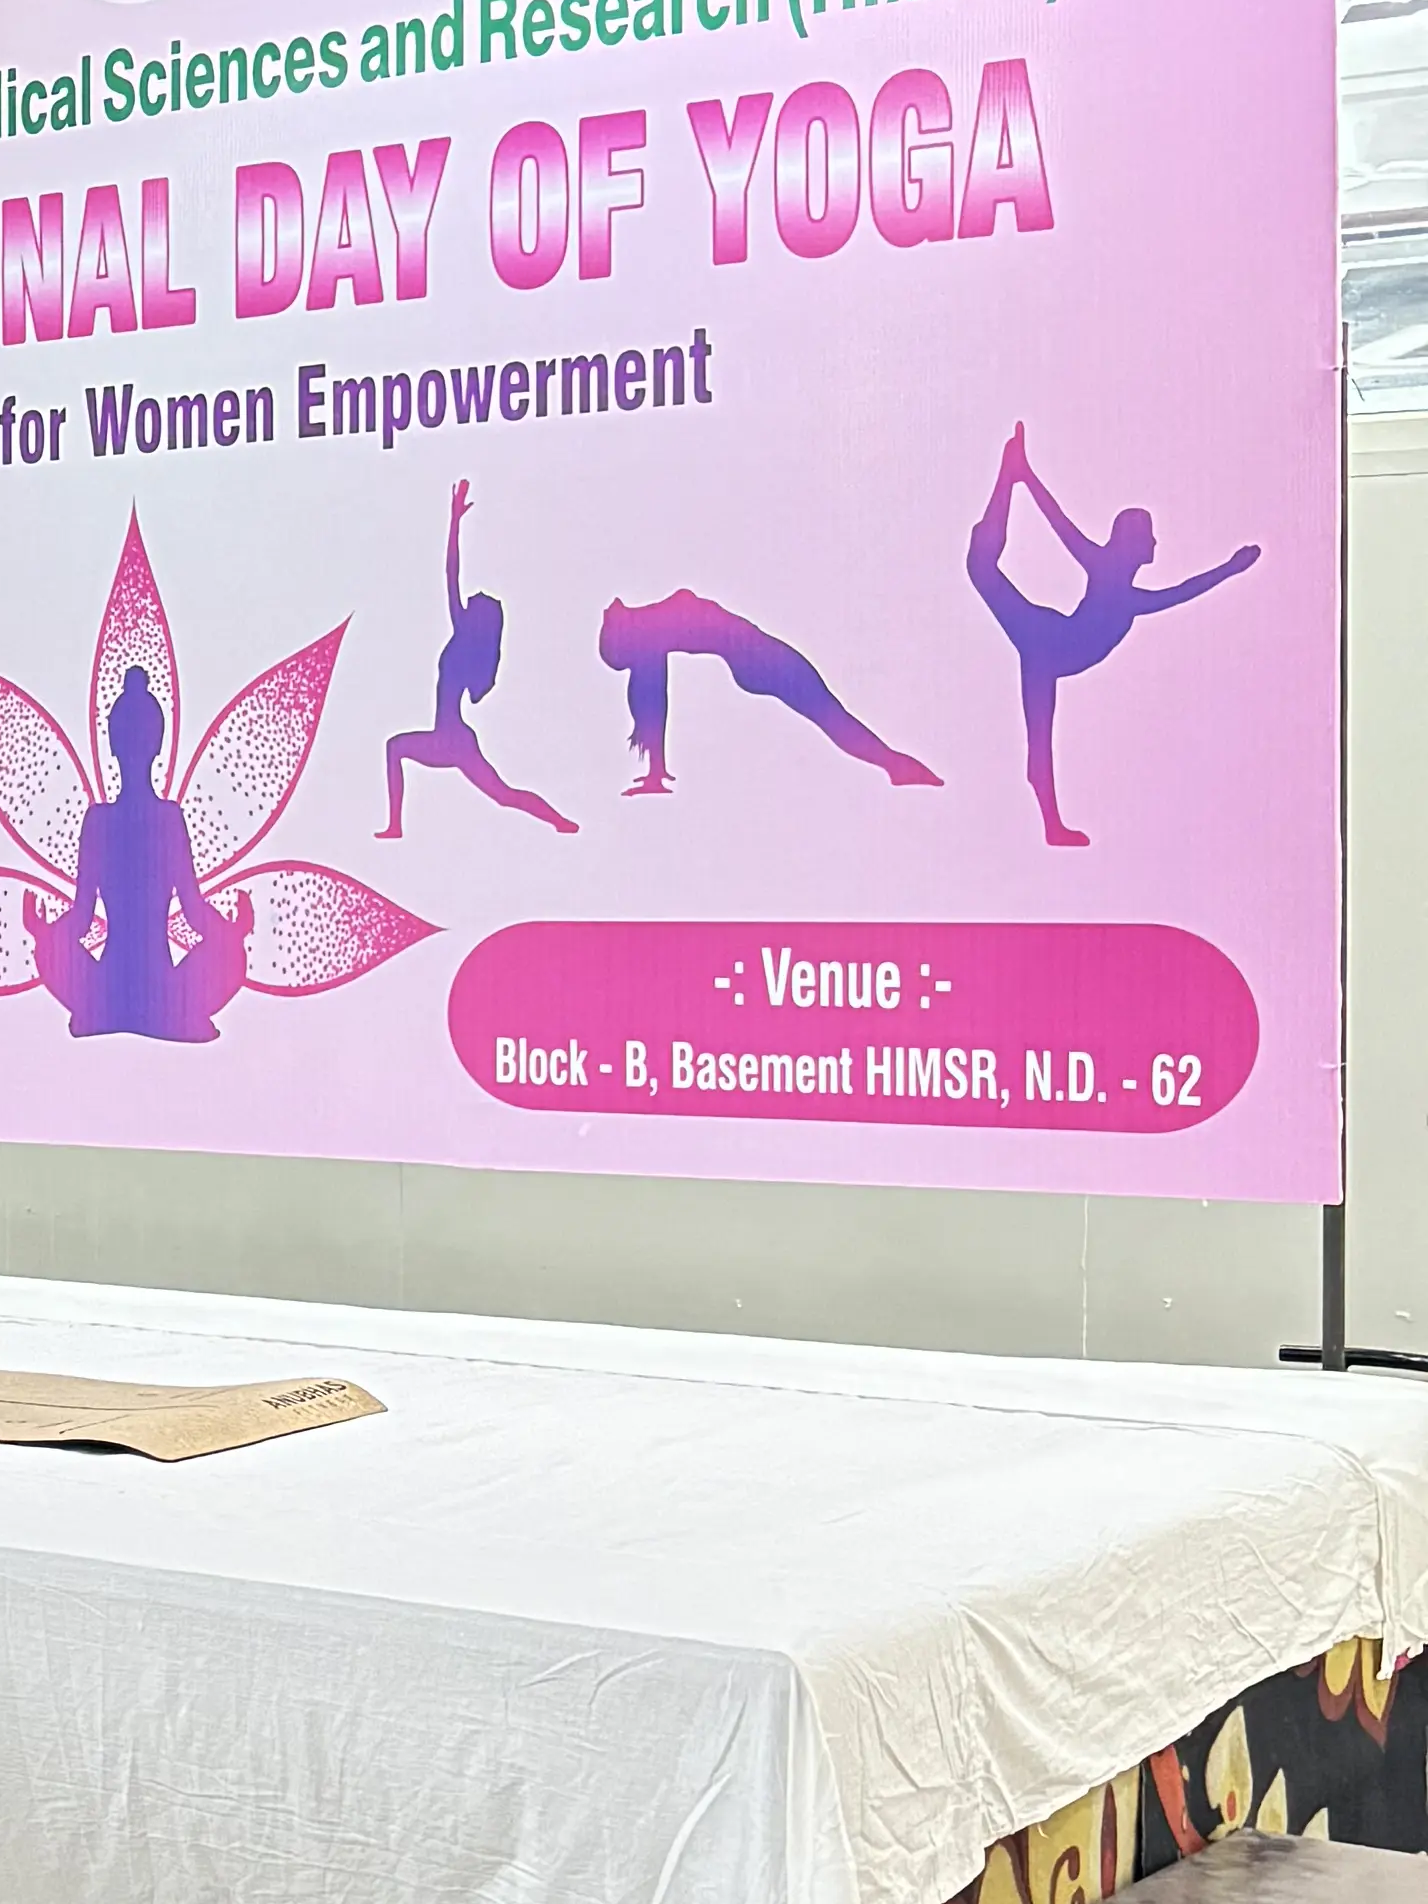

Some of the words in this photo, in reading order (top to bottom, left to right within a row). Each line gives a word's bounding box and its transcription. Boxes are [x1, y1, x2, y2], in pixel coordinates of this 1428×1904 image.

[104, 38, 347, 123] Sciences
[235, 137, 452, 319] DAY
[489, 109, 648, 291] OF
[687, 58, 1055, 266] YOGA
[86, 381, 274, 454] Women
[297, 328, 713, 450] Empowerment
[761, 946, 902, 1010] Venue
[494, 1035, 589, 1087] Block
[625, 1040, 658, 1096] B,
[671, 1040, 854, 1096] Basement
[865, 1046, 1010, 1108] HIMSR,
[1025, 1052, 1109, 1104] N.D.
[1150, 1053, 1203, 1108] 62
